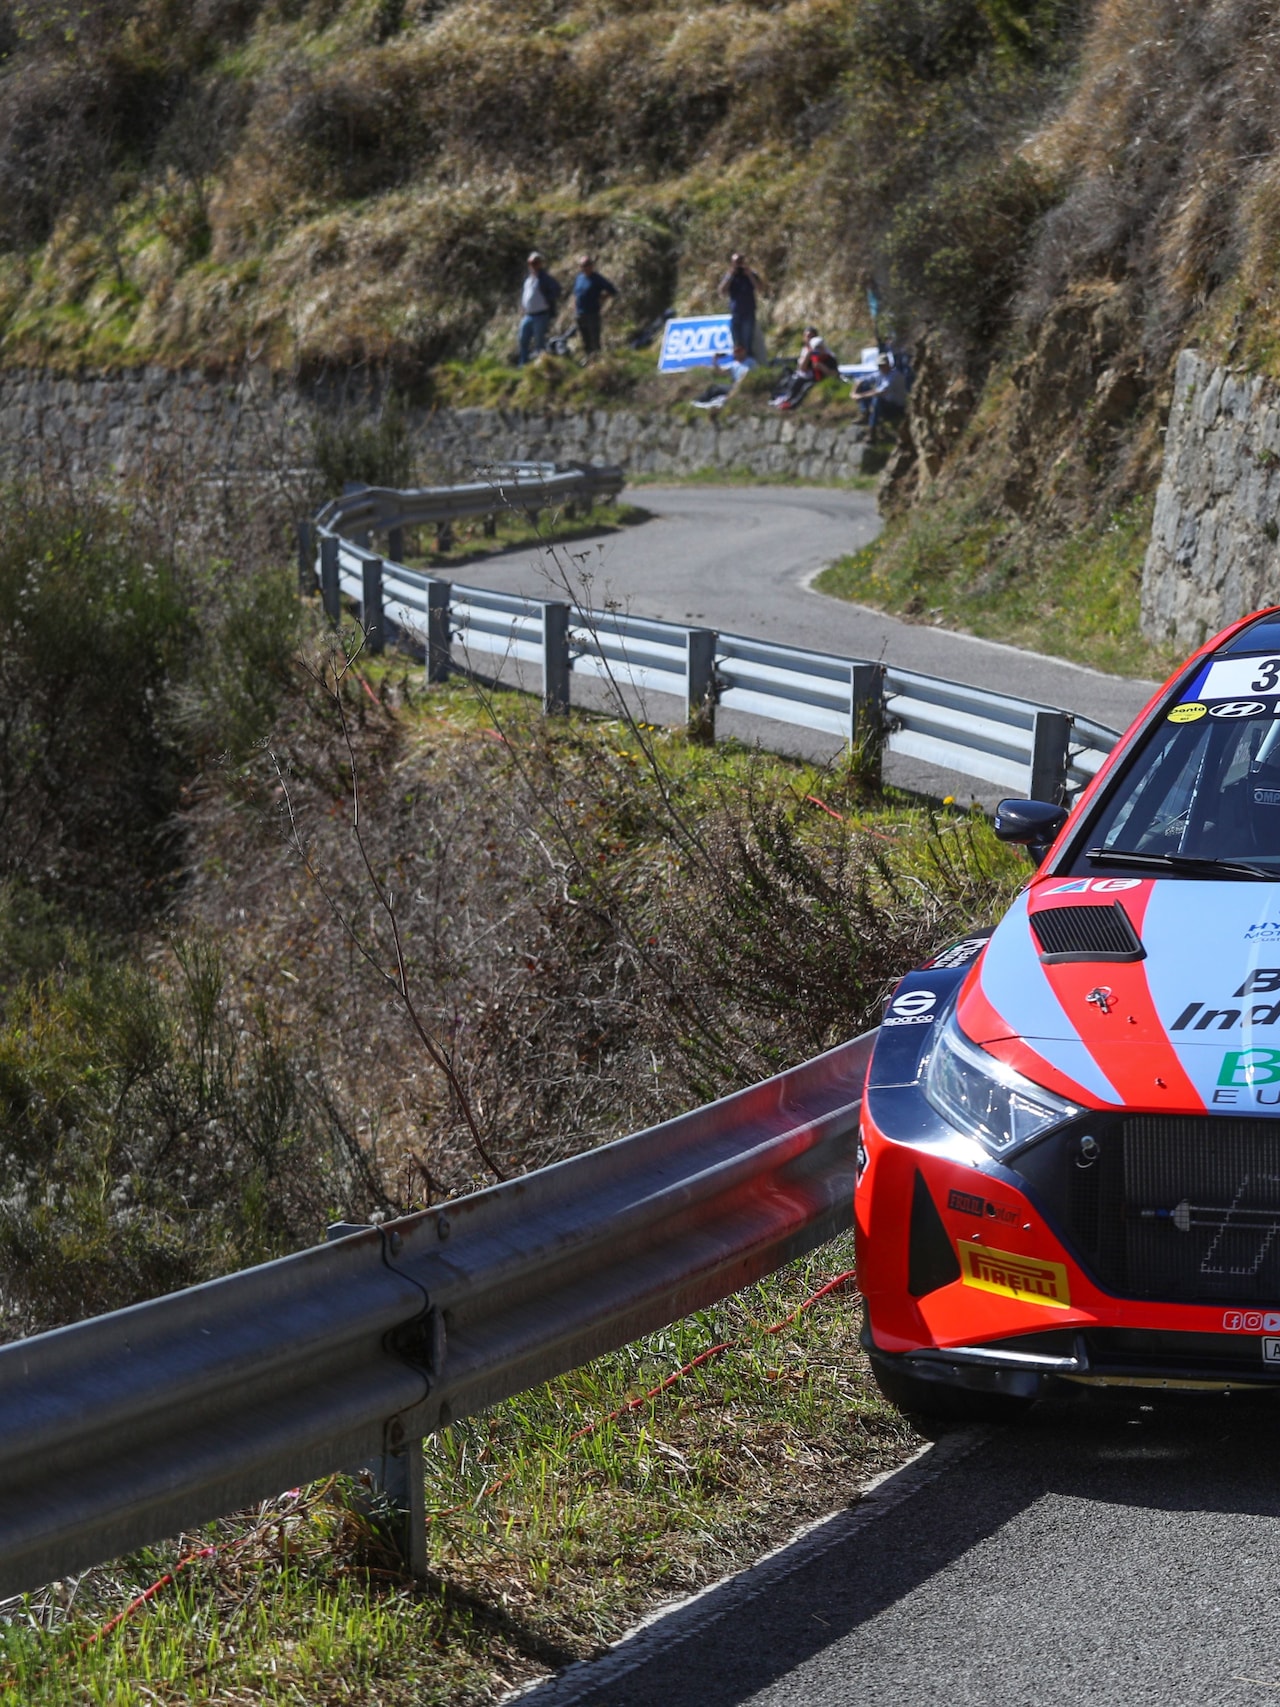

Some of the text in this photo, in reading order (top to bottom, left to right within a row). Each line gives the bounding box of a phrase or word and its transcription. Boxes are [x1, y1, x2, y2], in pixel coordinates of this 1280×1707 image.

[665, 325, 734, 361] sparc
[1253, 790, 1280, 803] OMP
[882, 1015, 934, 1026] sparco
[968, 1251, 1057, 1298] PIRELLI
